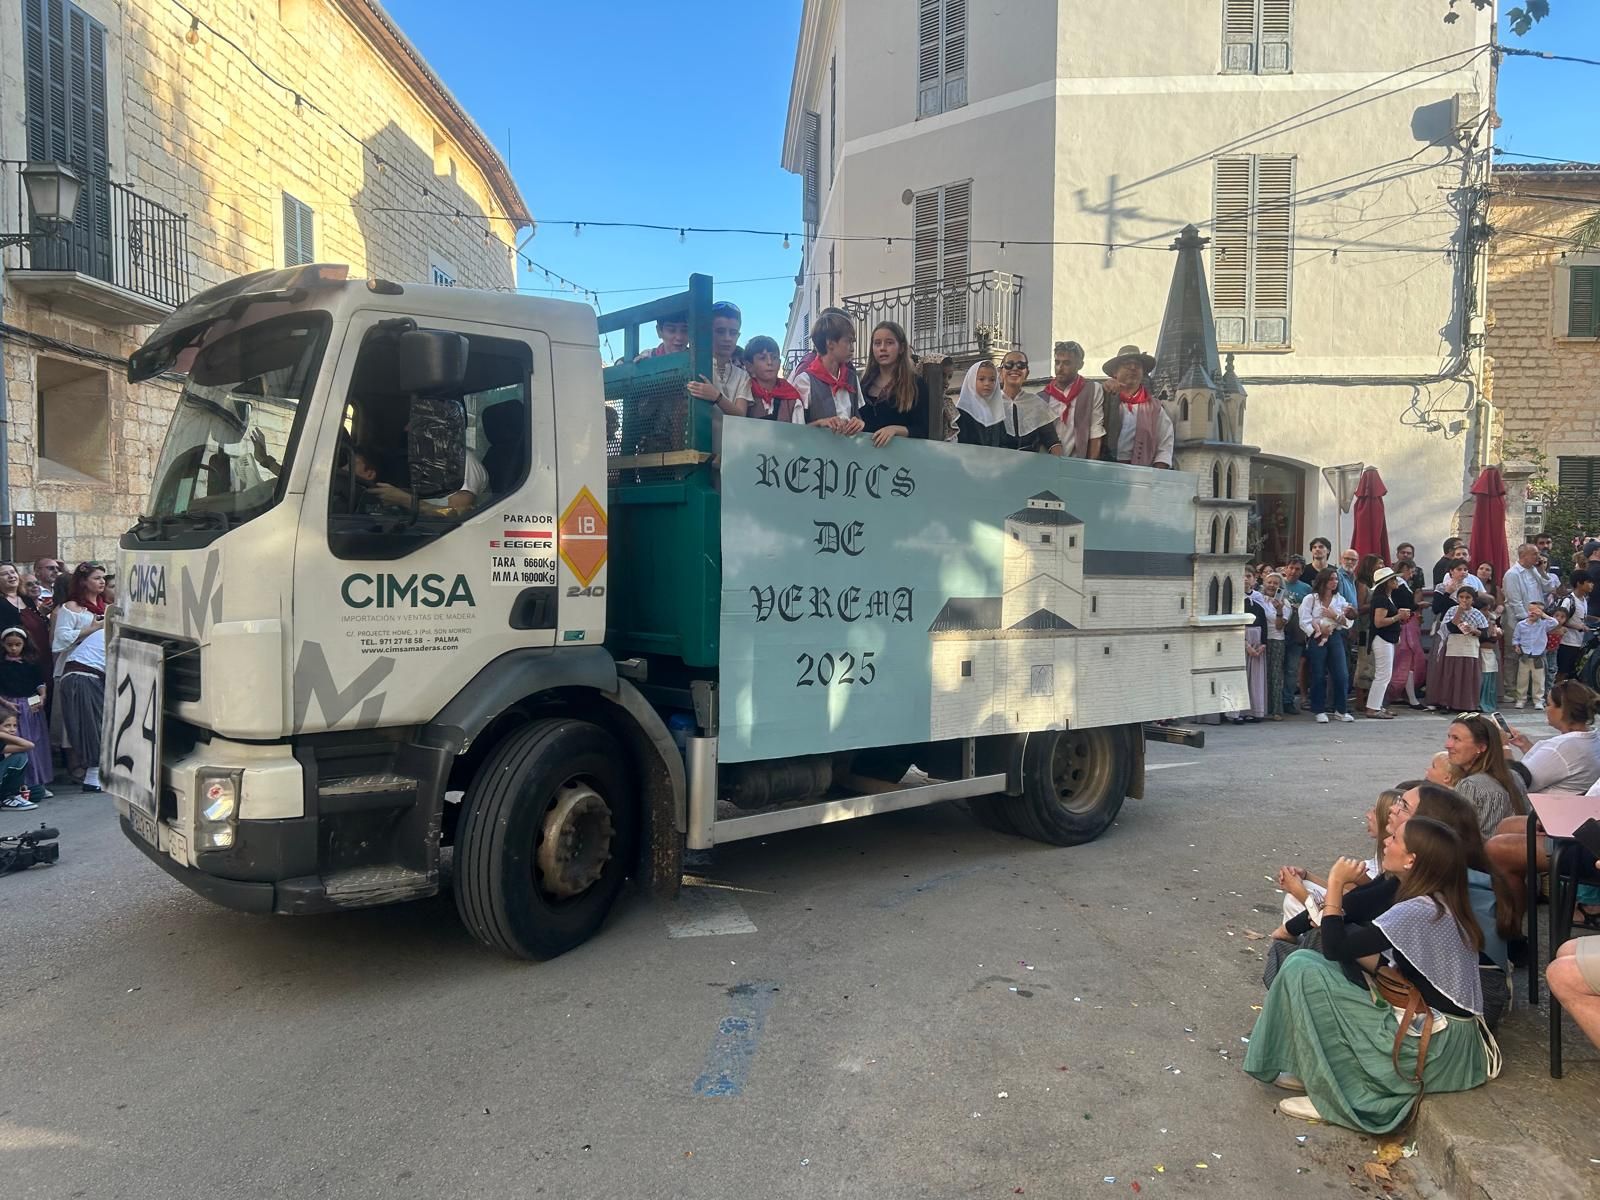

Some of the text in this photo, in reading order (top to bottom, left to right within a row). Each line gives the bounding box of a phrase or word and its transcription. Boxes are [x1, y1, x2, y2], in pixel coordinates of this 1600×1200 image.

[503, 514, 553, 524] PARADOR
[503, 540, 552, 549] EGGER
[813, 519, 866, 557] DE
[492, 556, 555, 571] TARA 6660Kg
[129, 564, 167, 606] CIMSA
[341, 573, 476, 608] CIMSA
[521, 571, 556, 585] 16000Kg
[566, 586, 605, 598] 240
[750, 583, 916, 623] VEREMA
[361, 645, 459, 654] www.cimsamaderas.com
[796, 651, 877, 687] 2025
[114, 673, 157, 790] 24
